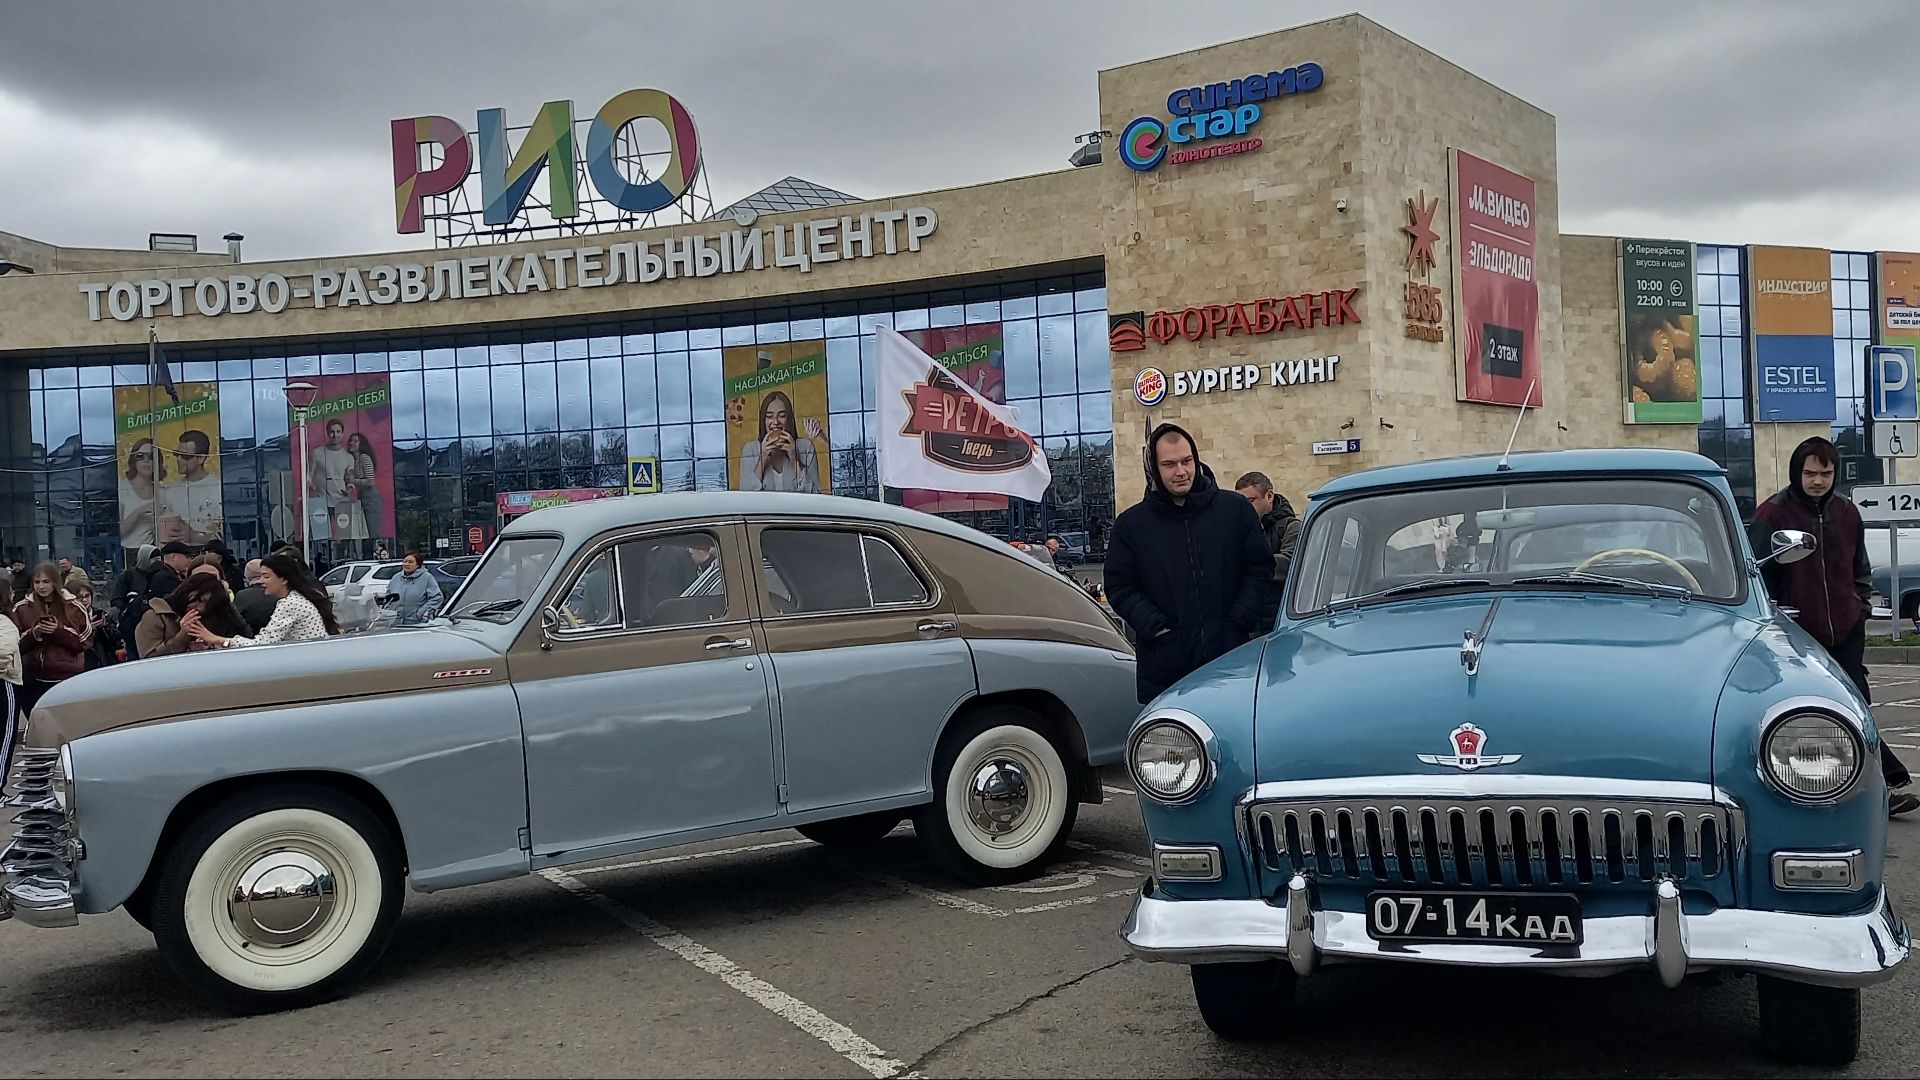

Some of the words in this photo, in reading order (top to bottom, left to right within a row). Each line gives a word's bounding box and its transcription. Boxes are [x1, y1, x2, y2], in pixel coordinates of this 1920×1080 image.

[391, 88, 701, 234] РИО
[1168, 137, 1264, 165] КИНОТЕАТР
[1469, 240, 1532, 282] ЭЛЬДОРАДО
[1635, 244, 1686, 256] Перекрёсток
[79, 207, 764, 321] ТОРГОВО-РАЗВЛЕКАТЕЛЬНЫЙ
[773, 207, 938, 273] ЦЕНТР
[1636, 260, 1660, 268] вкусов
[1667, 260, 1686, 268] идей
[1636, 280, 1663, 291] 10:00
[1757, 279, 1828, 293] ИНДУСТРИЯ
[1405, 281, 1443, 323] 585
[1637, 295, 1664, 307] 22:00
[1666, 299, 1671, 307] 1
[1149, 288, 1362, 345] ФОРАБАНК
[935, 344, 988, 370] ОВАТЬСЯ
[1489, 338, 1496, 358] 2
[1497, 344, 1519, 363] этаж
[734, 360, 816, 393] НАСЛАЖДАТЬСЯ
[1138, 374, 1161, 389] BURGER
[1173, 364, 1261, 396] БУРГЕР
[1270, 355, 1341, 387] КИНГ
[1764, 366, 1827, 385] ESTEL
[1879, 353, 1909, 413] P
[357, 389, 385, 406] СЕБЯ
[1139, 380, 1163, 398] KING
[960, 438, 994, 460] Тверь
[1350, 441, 1357, 451] 5
